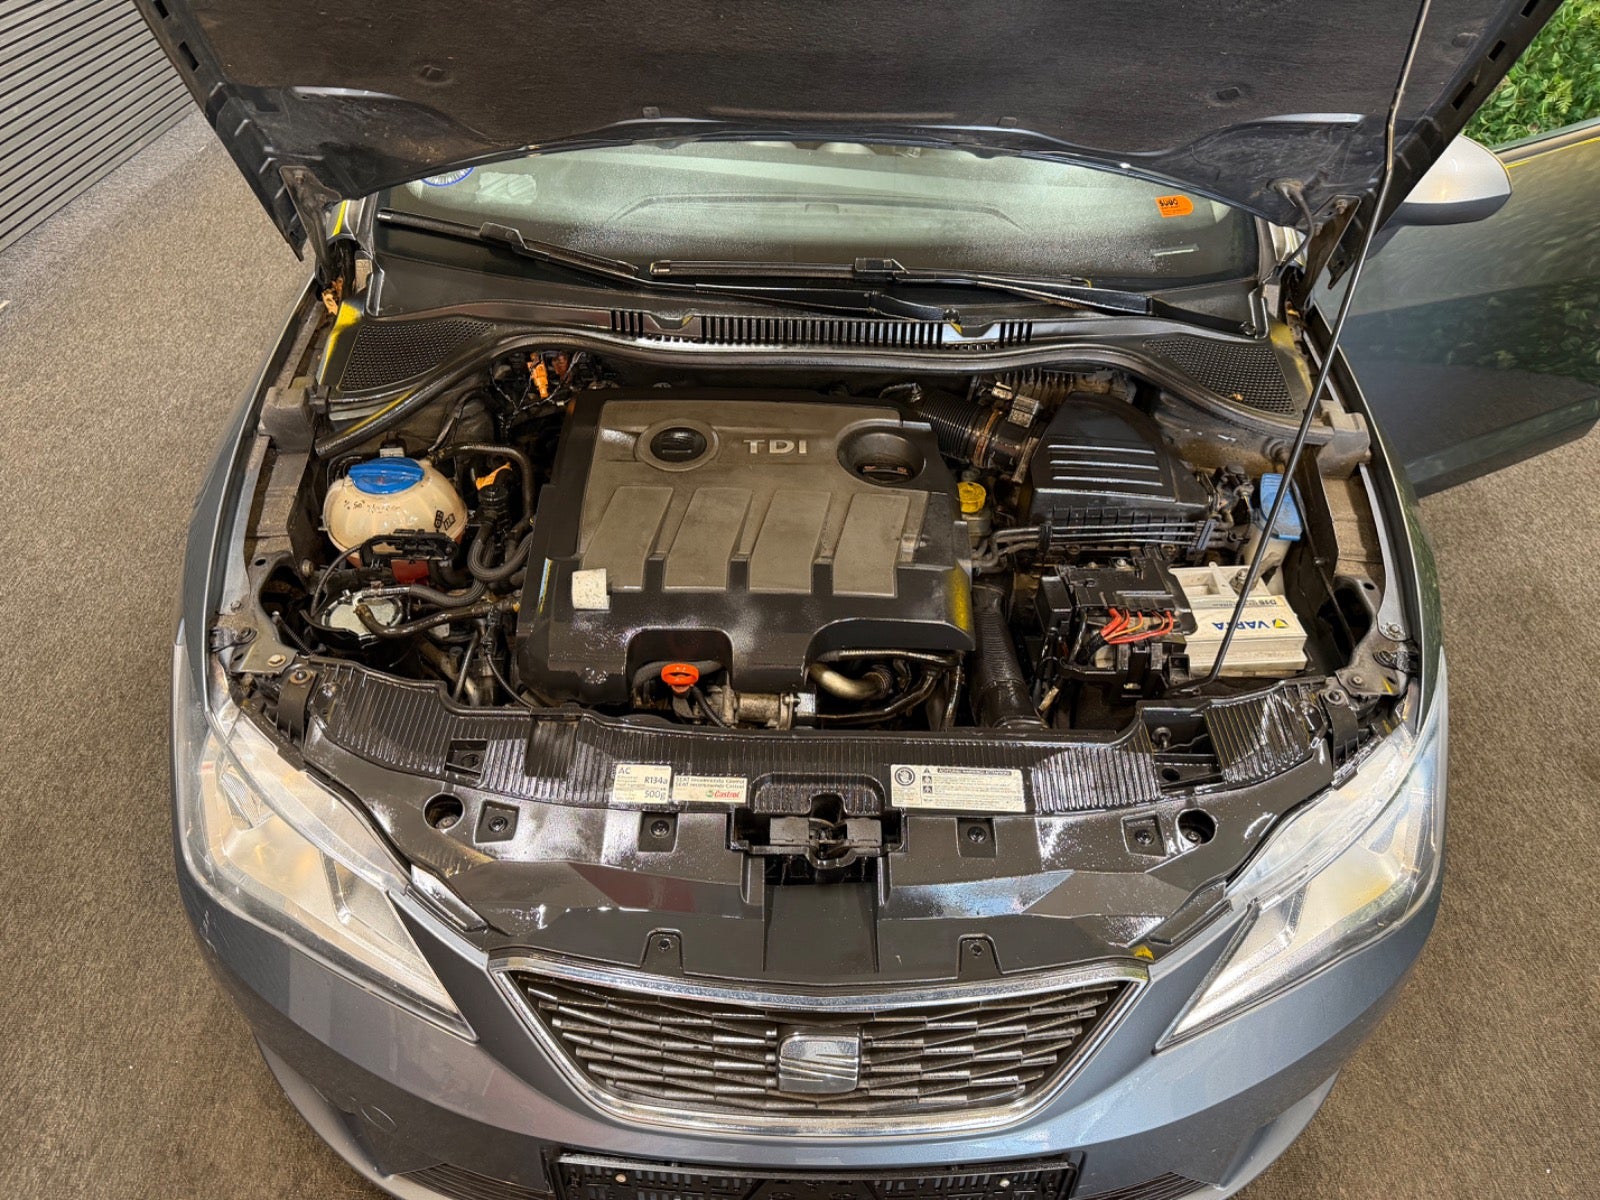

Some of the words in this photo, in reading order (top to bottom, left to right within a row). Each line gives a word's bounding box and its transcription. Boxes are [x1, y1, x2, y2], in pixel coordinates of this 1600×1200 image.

[743, 439, 808, 455] TDI
[1212, 620, 1270, 630] VARA
[644, 776, 668, 785] R134a
[644, 790, 667, 800] 500g
[714, 789, 740, 798] Castrol
